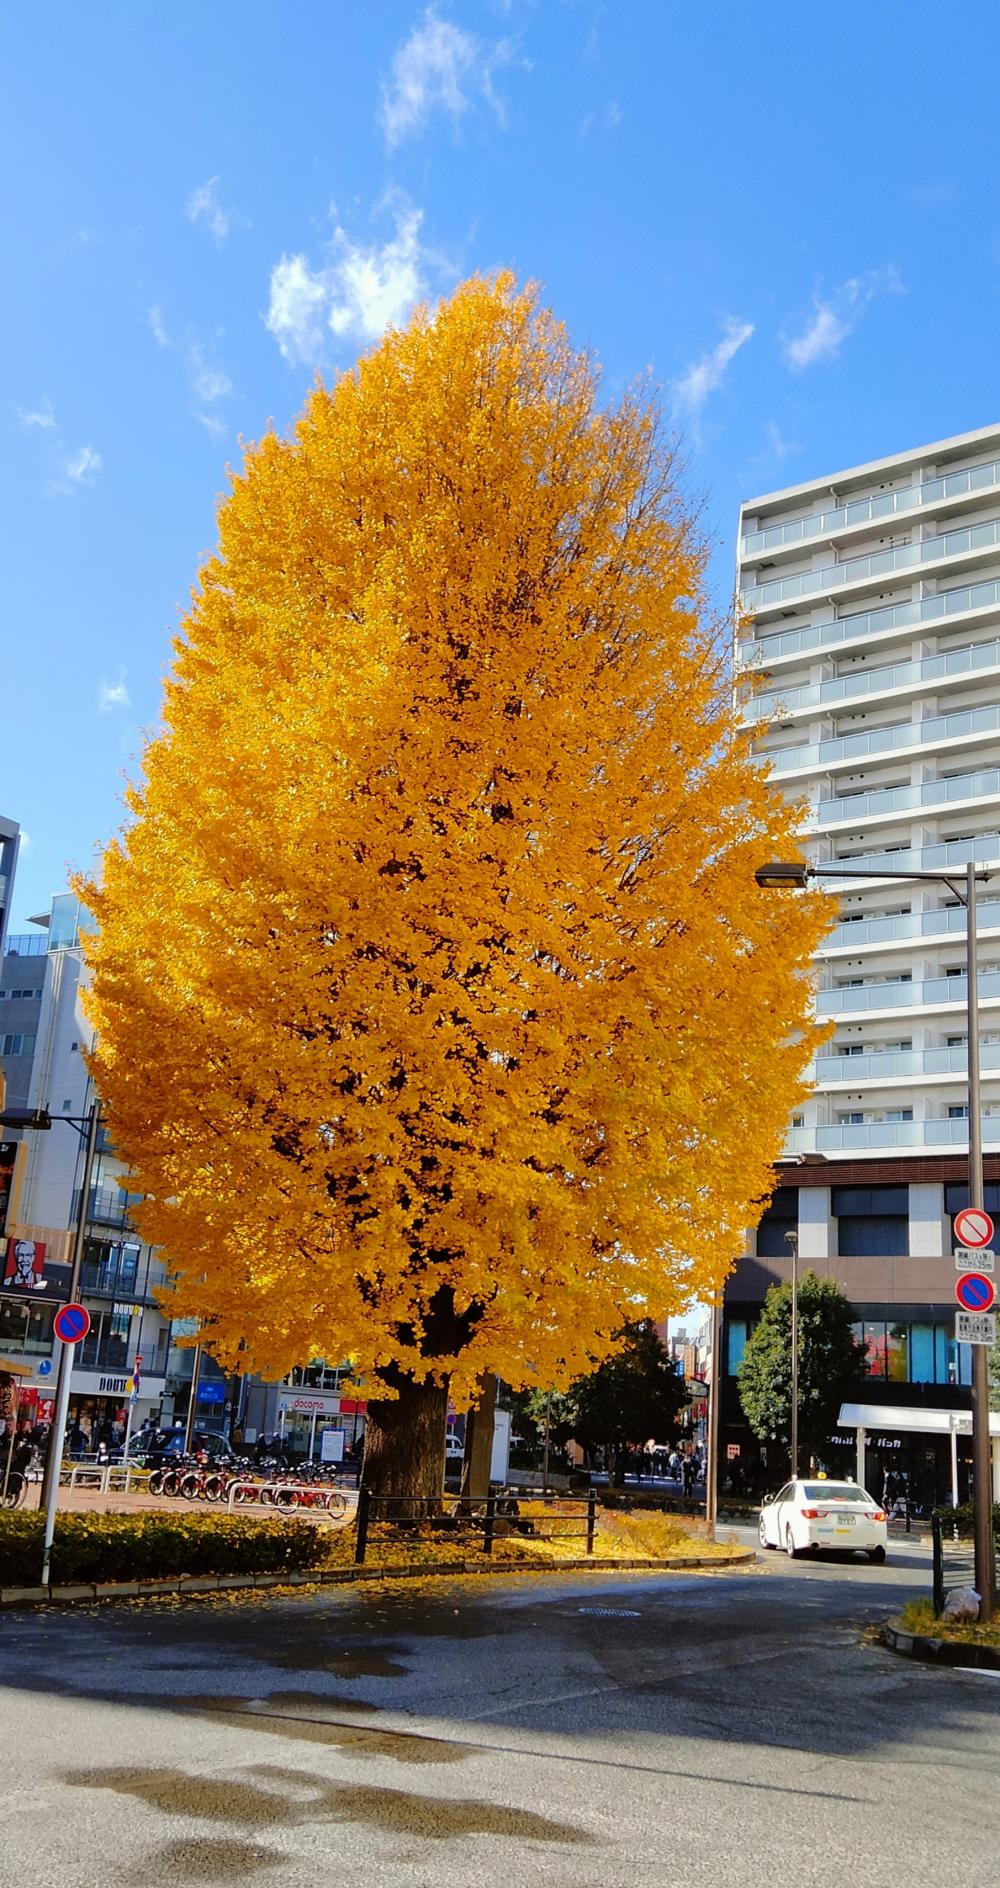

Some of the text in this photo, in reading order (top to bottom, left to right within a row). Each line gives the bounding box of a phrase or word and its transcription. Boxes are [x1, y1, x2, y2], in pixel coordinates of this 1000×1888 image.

[113, 1303, 144, 1317] DOUTOR
[99, 1377, 139, 1393] DOUTO
[294, 1397, 325, 1409] docomo
